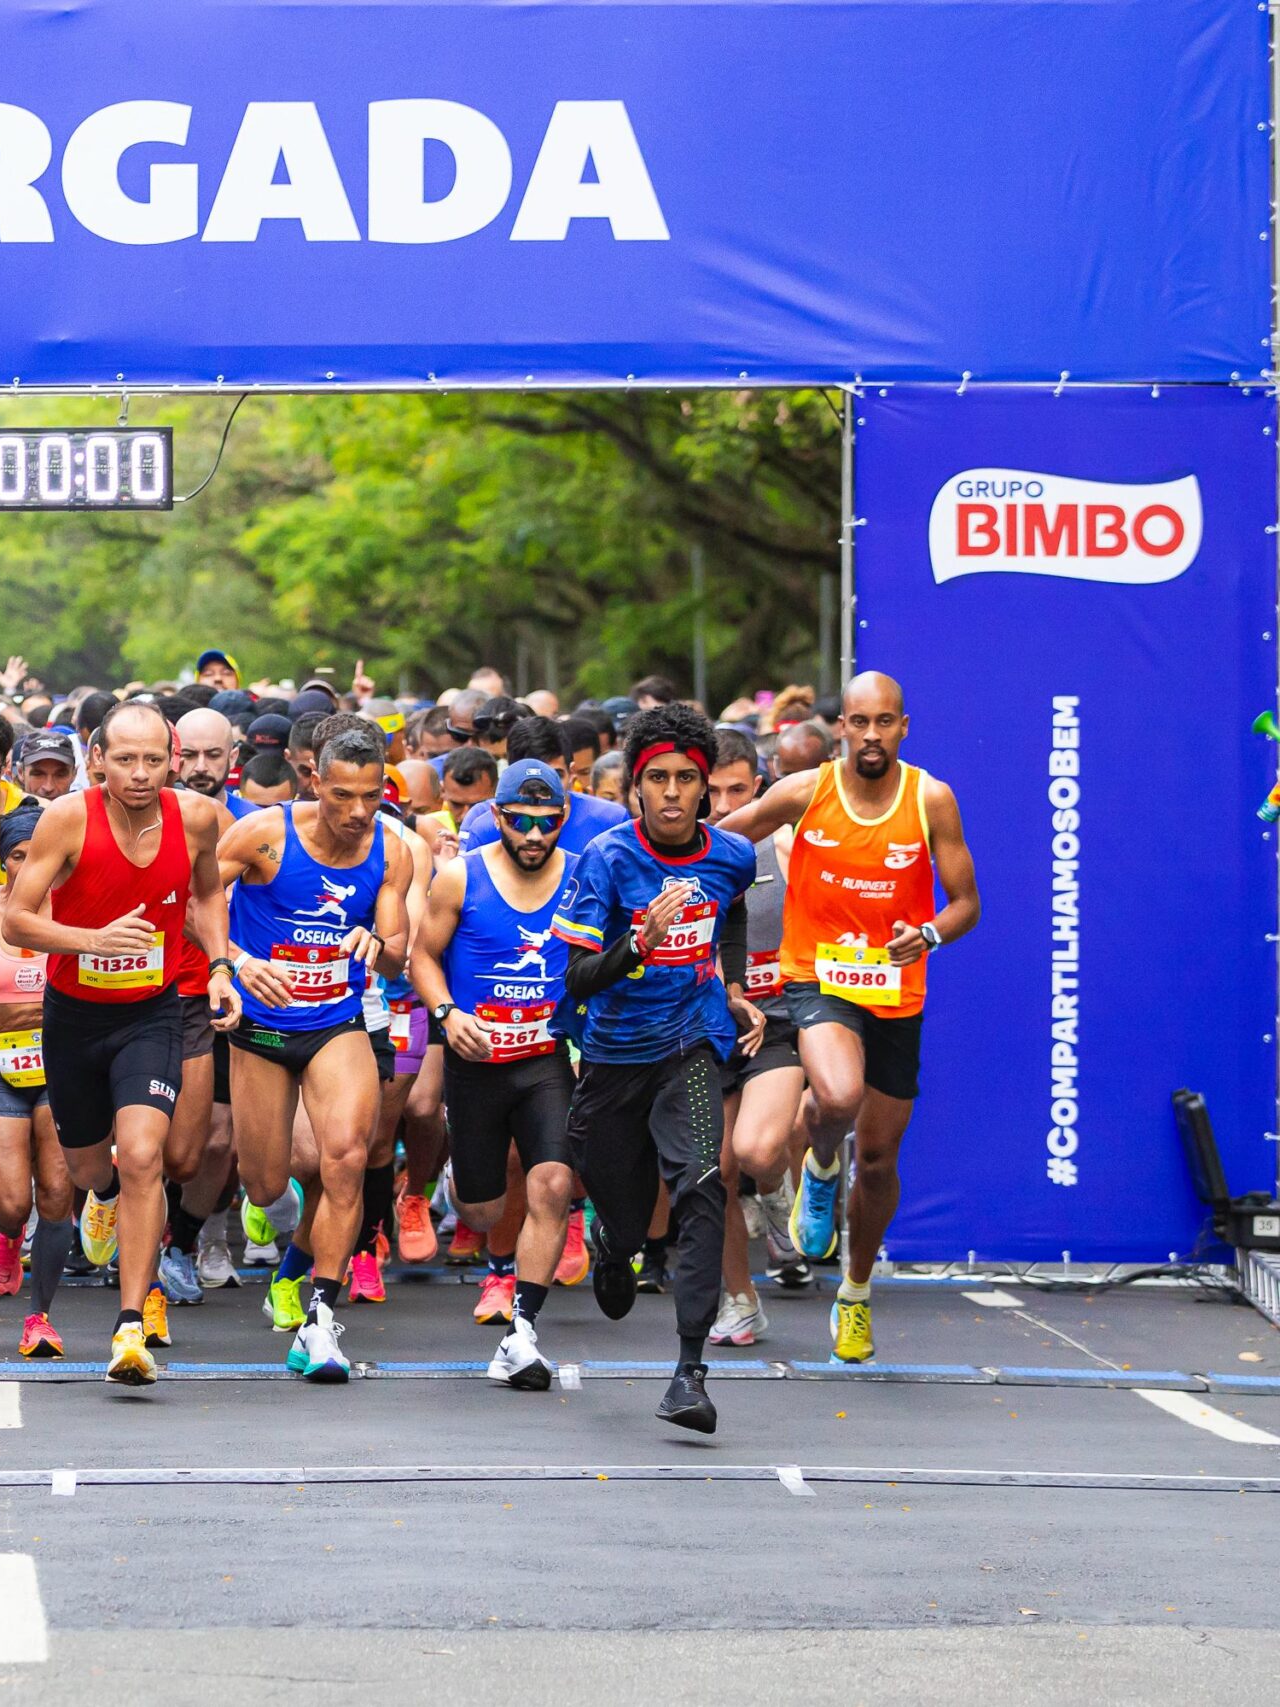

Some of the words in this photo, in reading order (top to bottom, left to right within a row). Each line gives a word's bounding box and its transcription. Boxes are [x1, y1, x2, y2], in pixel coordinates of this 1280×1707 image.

[956, 480, 1044, 498] GRUPO
[956, 503, 1185, 557] BIMBO
[293, 928, 343, 945] OSEIAS
[660, 930, 699, 948] 206
[1046, 695, 1081, 1187] #COMPARTILHAMOSOBEM
[90, 956, 148, 972] 11326
[826, 969, 887, 986] 10980
[494, 983, 546, 1000] OSEIAS
[490, 1029, 540, 1046] 6267
[10, 1053, 42, 1070] 121
